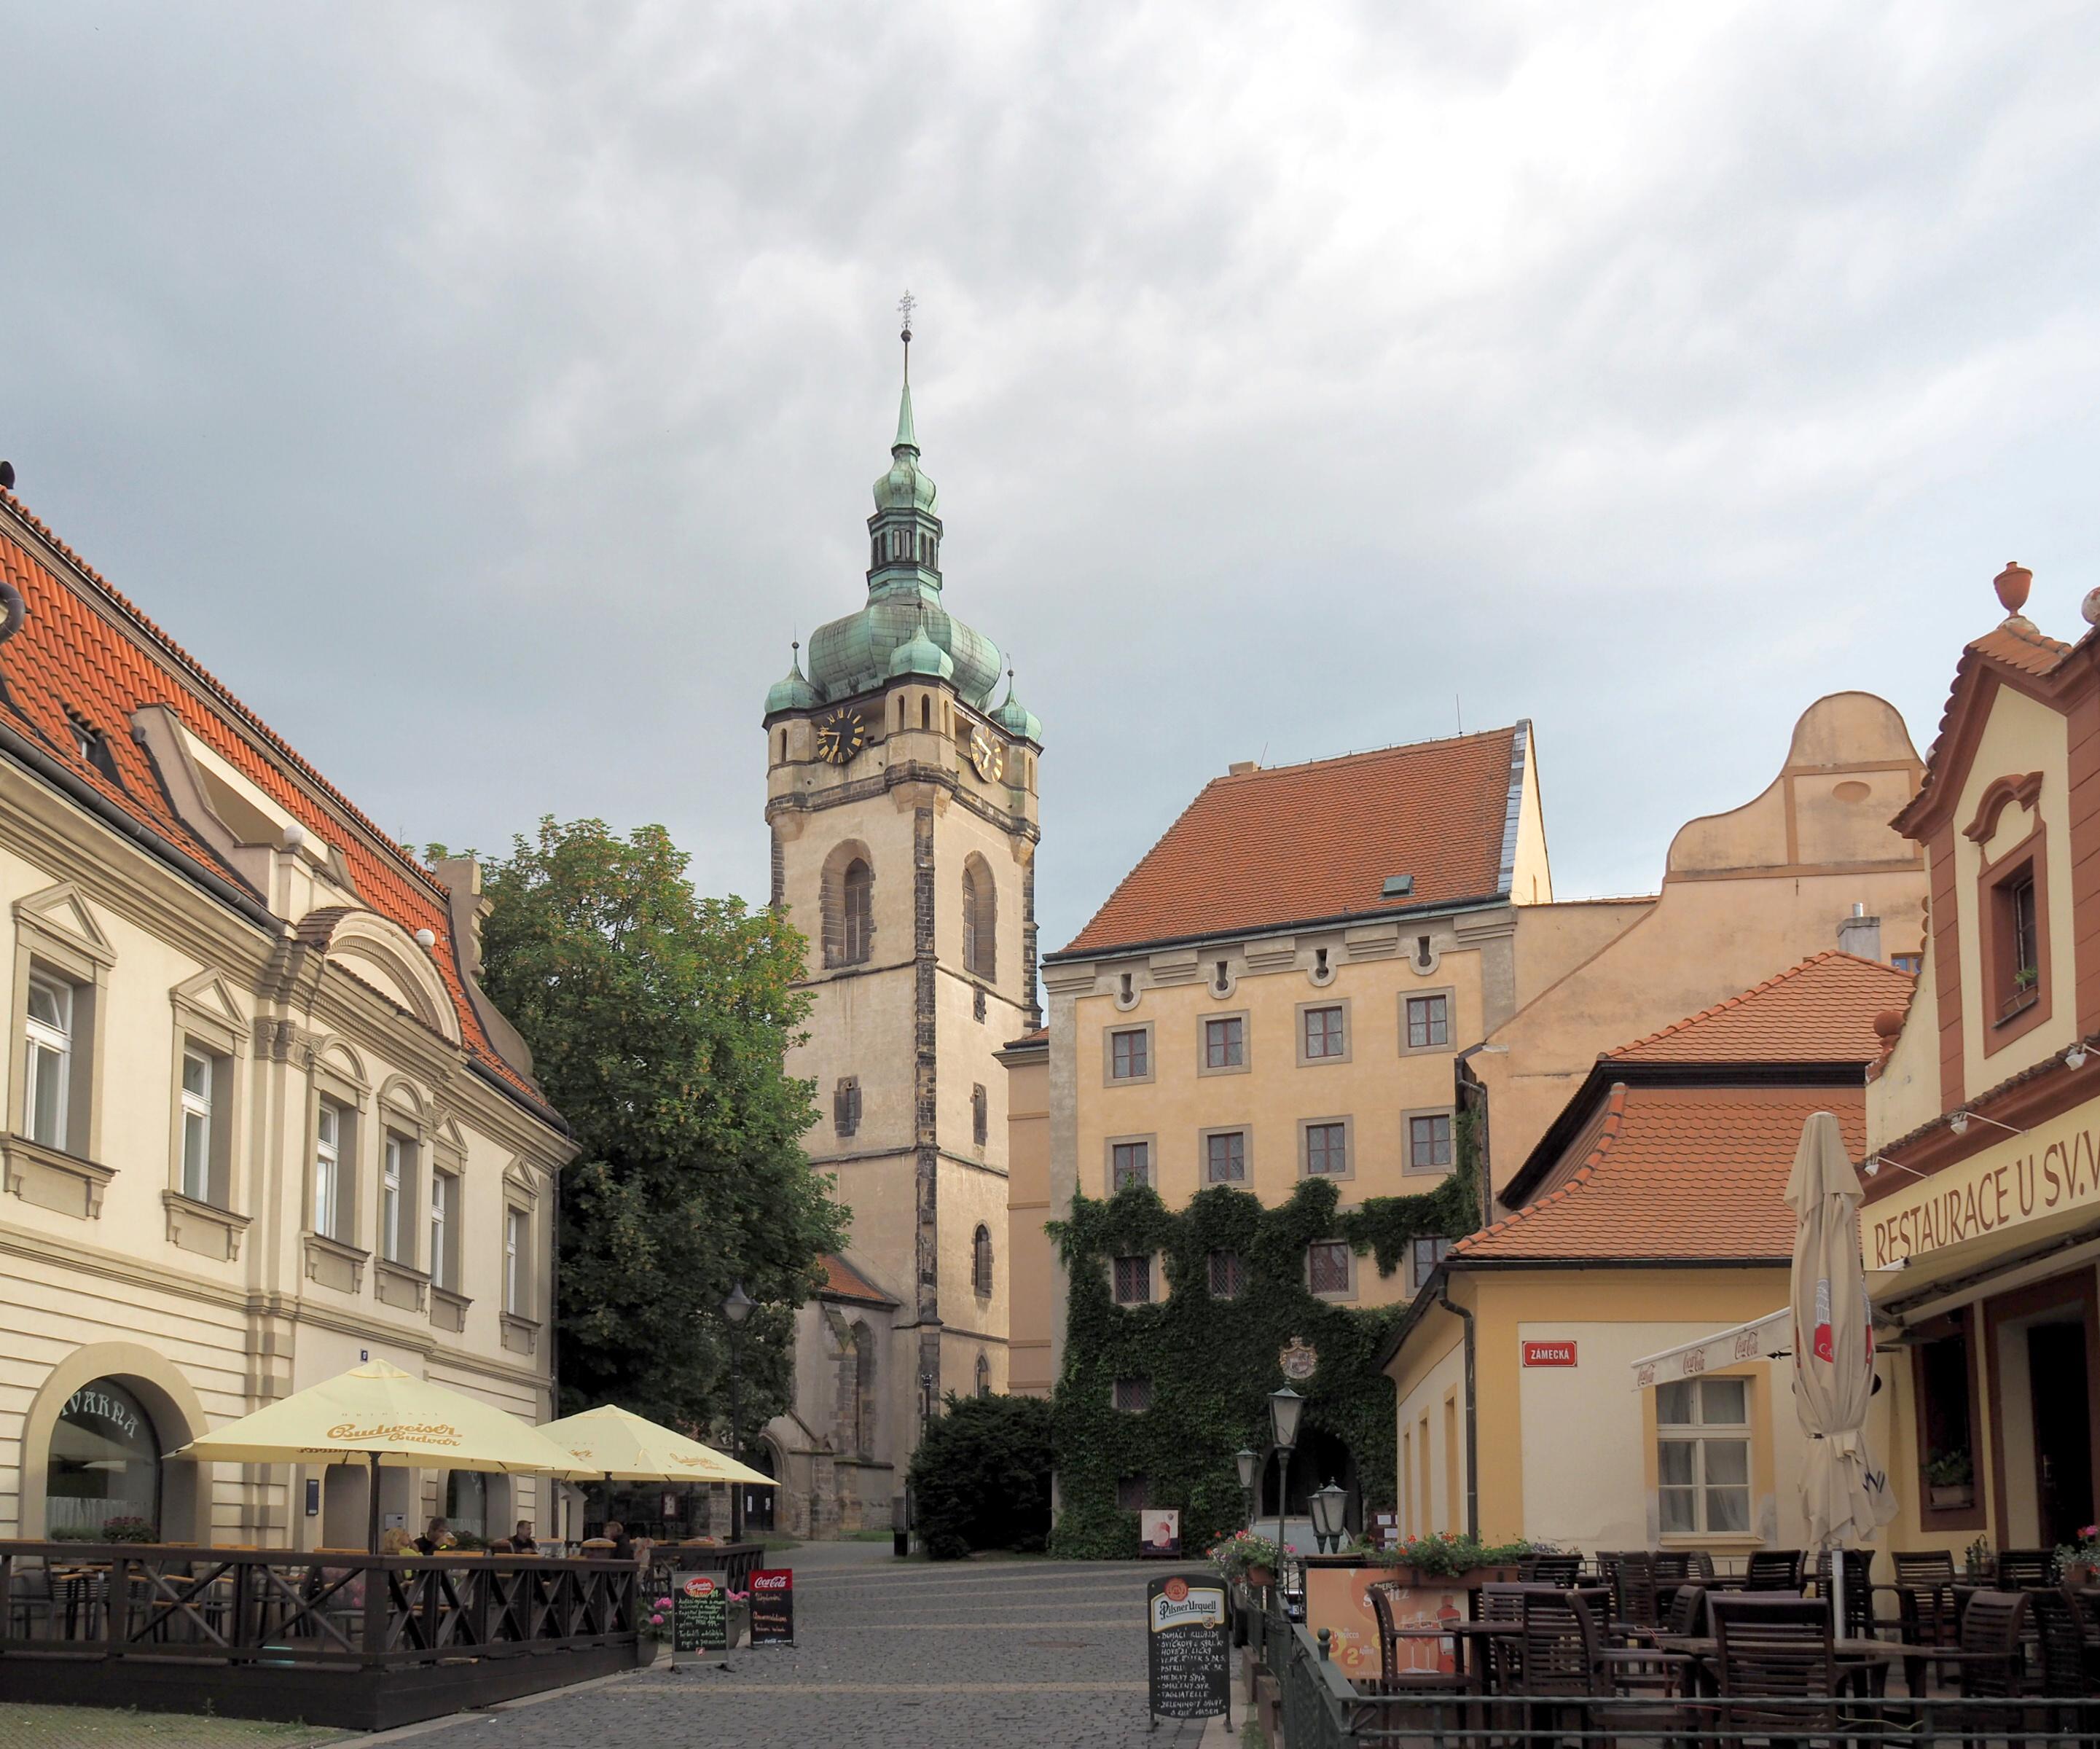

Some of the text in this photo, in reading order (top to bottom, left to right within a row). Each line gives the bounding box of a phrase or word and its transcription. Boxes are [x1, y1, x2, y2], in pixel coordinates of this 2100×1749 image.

[1874, 1166, 2010, 1268] RESTAURACE
[2016, 1154, 2034, 1216] U
[1530, 1347, 1570, 1360] ZÁMECKÁ
[326, 1423, 463, 1440] Budweiser
[388, 1431, 461, 1447] Budvar
[1159, 1600, 1216, 1621] Pilsner Urquell
[1333, 1632, 1360, 1640] Prosecco
[1347, 1647, 1359, 1664] 2
[1161, 1691, 1210, 1699] TAGLIATELLE
